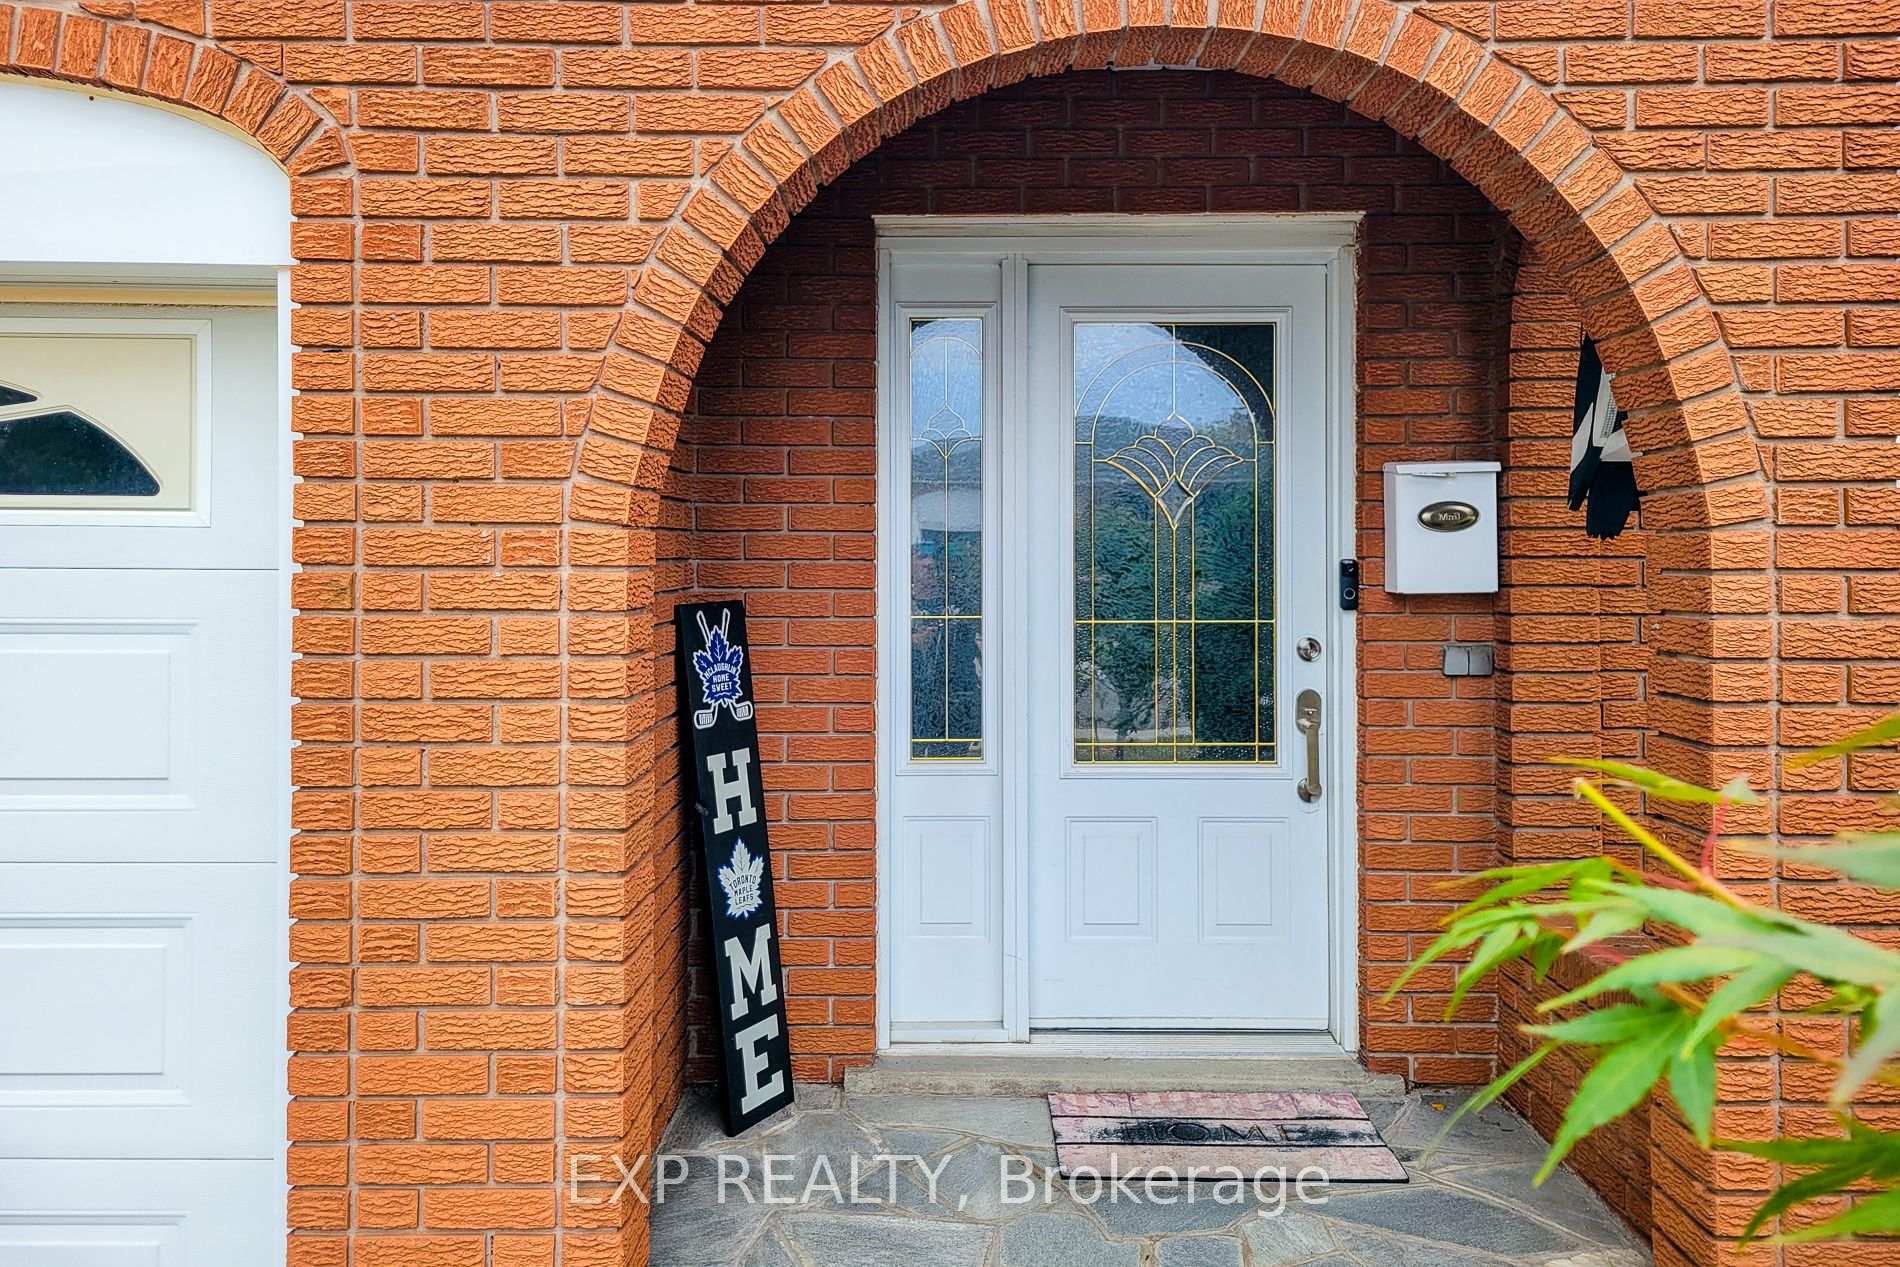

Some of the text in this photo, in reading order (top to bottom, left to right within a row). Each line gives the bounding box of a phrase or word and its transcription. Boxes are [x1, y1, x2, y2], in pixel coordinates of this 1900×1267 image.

[1438, 511, 1461, 521] Mail
[712, 673, 730, 683] HOME
[711, 682, 732, 692] SWEET
[729, 874, 757, 890] TORONTO
[734, 885, 753, 896] MAPLE
[735, 894, 753, 905] LEAFS
